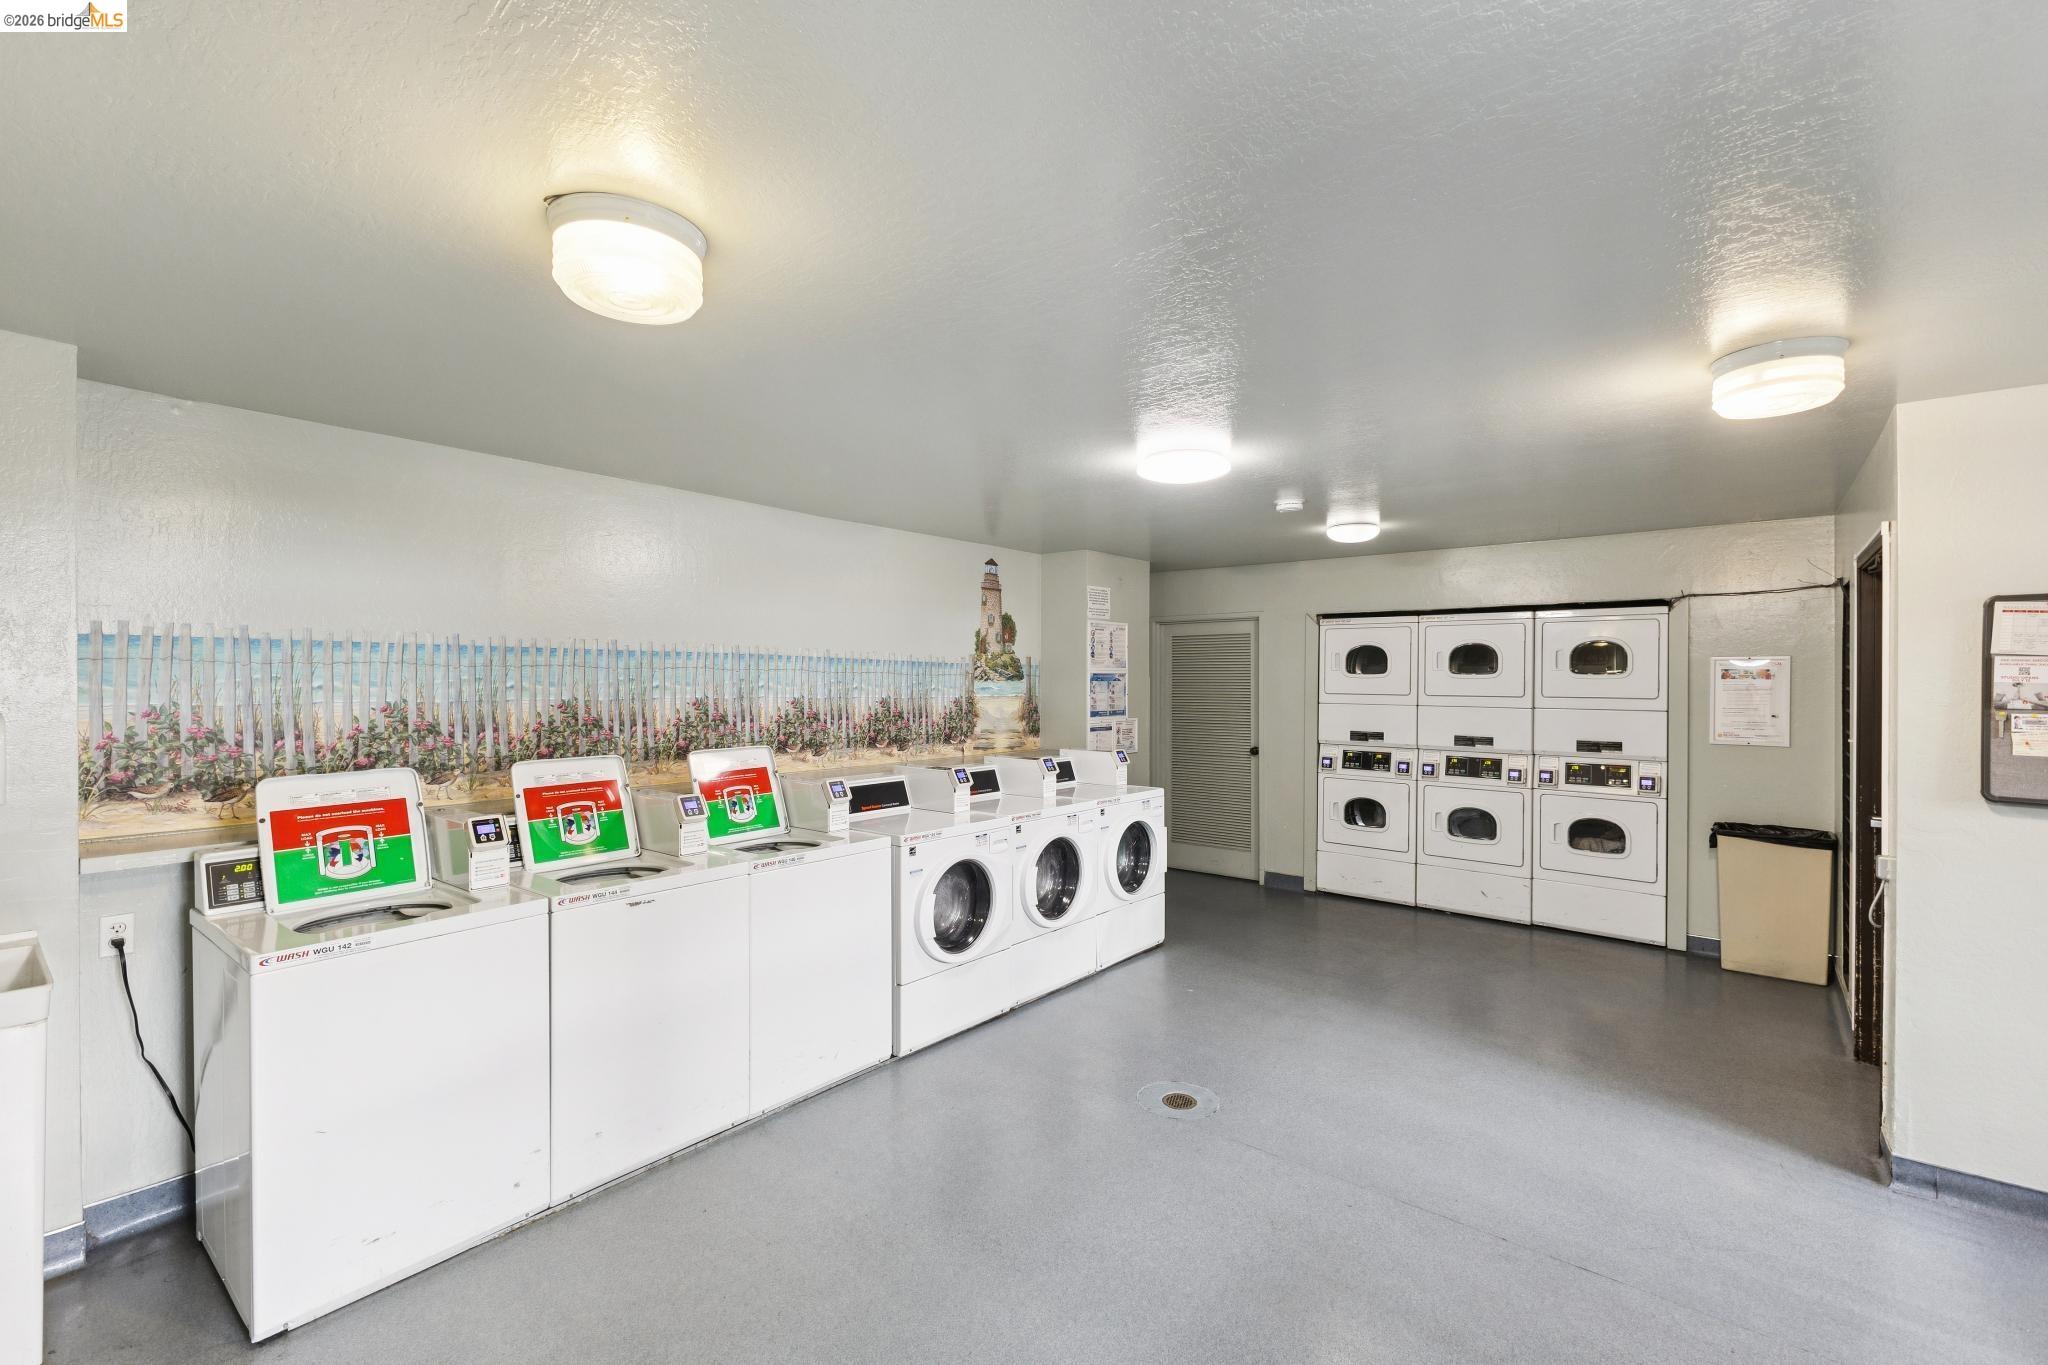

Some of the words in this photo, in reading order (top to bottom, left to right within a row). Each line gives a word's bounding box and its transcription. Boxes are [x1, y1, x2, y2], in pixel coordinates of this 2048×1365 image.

[234, 864, 253, 873] 2.00
[568, 894, 590, 903] WASH
[276, 950, 310, 962] WASH
[313, 946, 334, 955] WGU
[338, 942, 352, 950] 142
